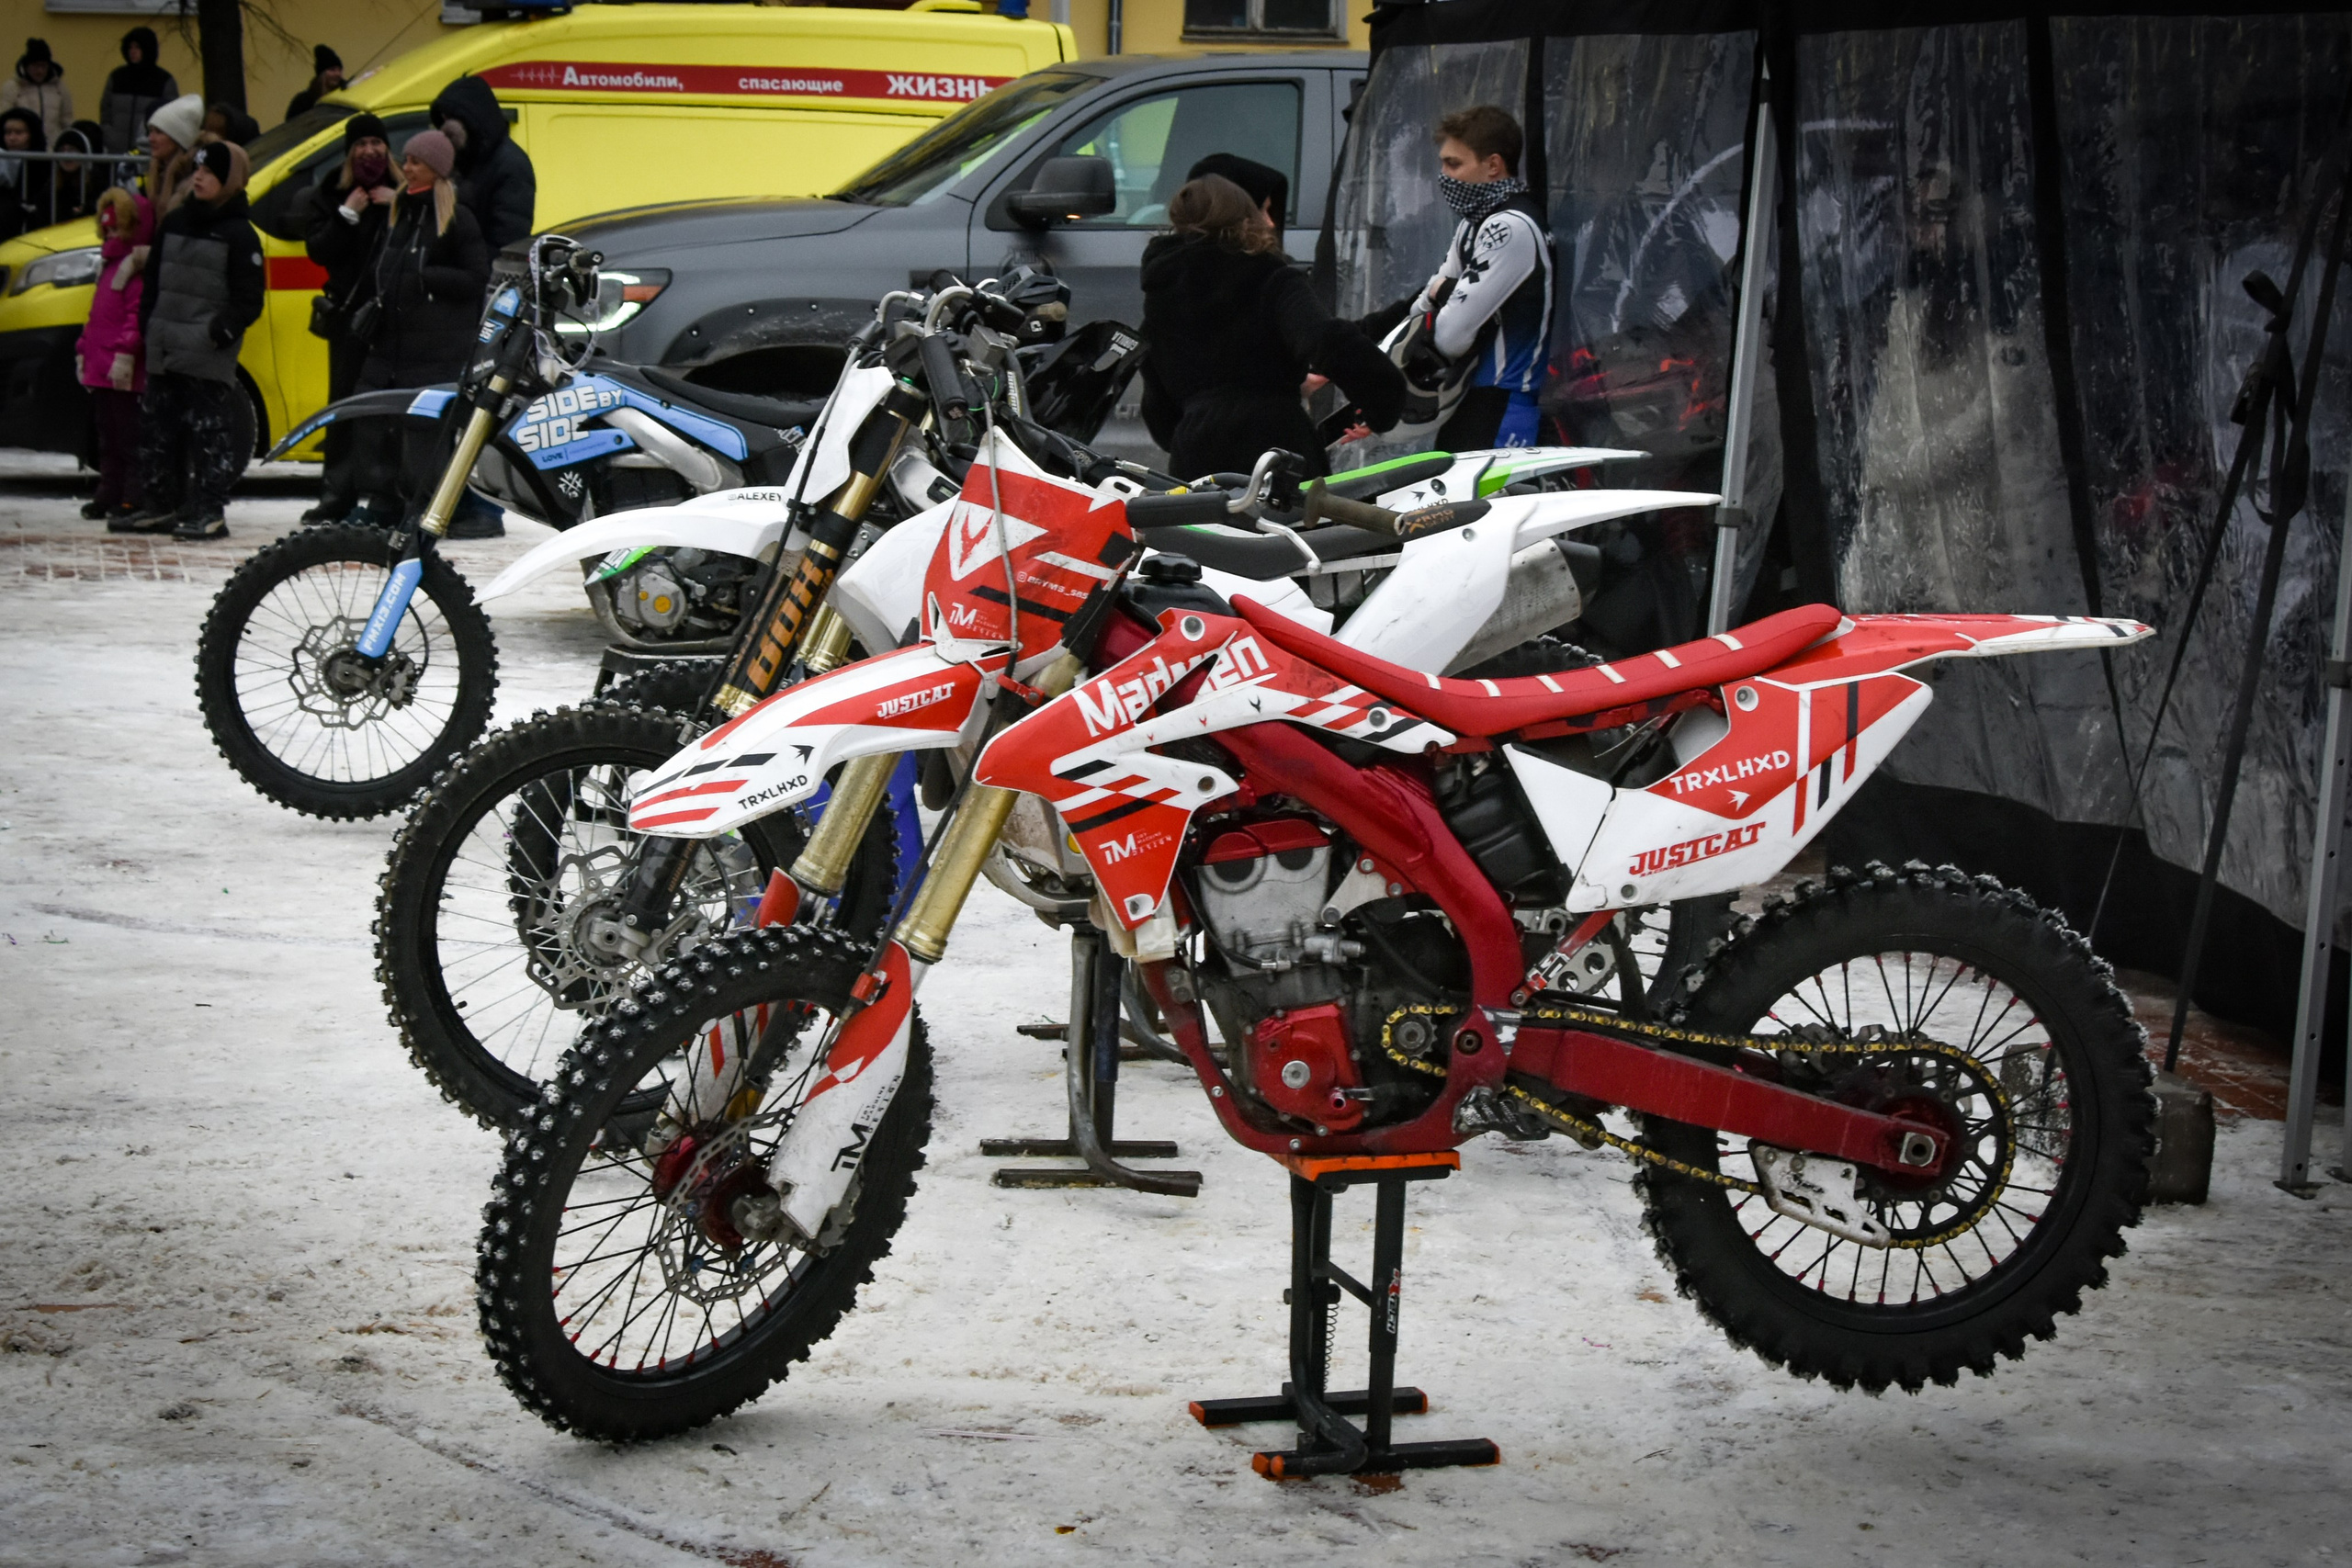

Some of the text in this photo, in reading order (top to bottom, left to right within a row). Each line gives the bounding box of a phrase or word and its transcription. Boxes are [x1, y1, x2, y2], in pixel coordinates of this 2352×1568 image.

[562, 65, 684, 91] Автомобили,
[738, 76, 843, 93] спасающие
[526, 385, 623, 423] SIDE BY
[515, 412, 590, 454] SIDE
[541, 451, 564, 463] LOVE
[876, 682, 956, 718] JUSTCAT
[1668, 750, 1791, 795] TRXLHXD
[738, 773, 808, 810] TRXLHXD
[1628, 820, 1767, 875] JUSTCAT
